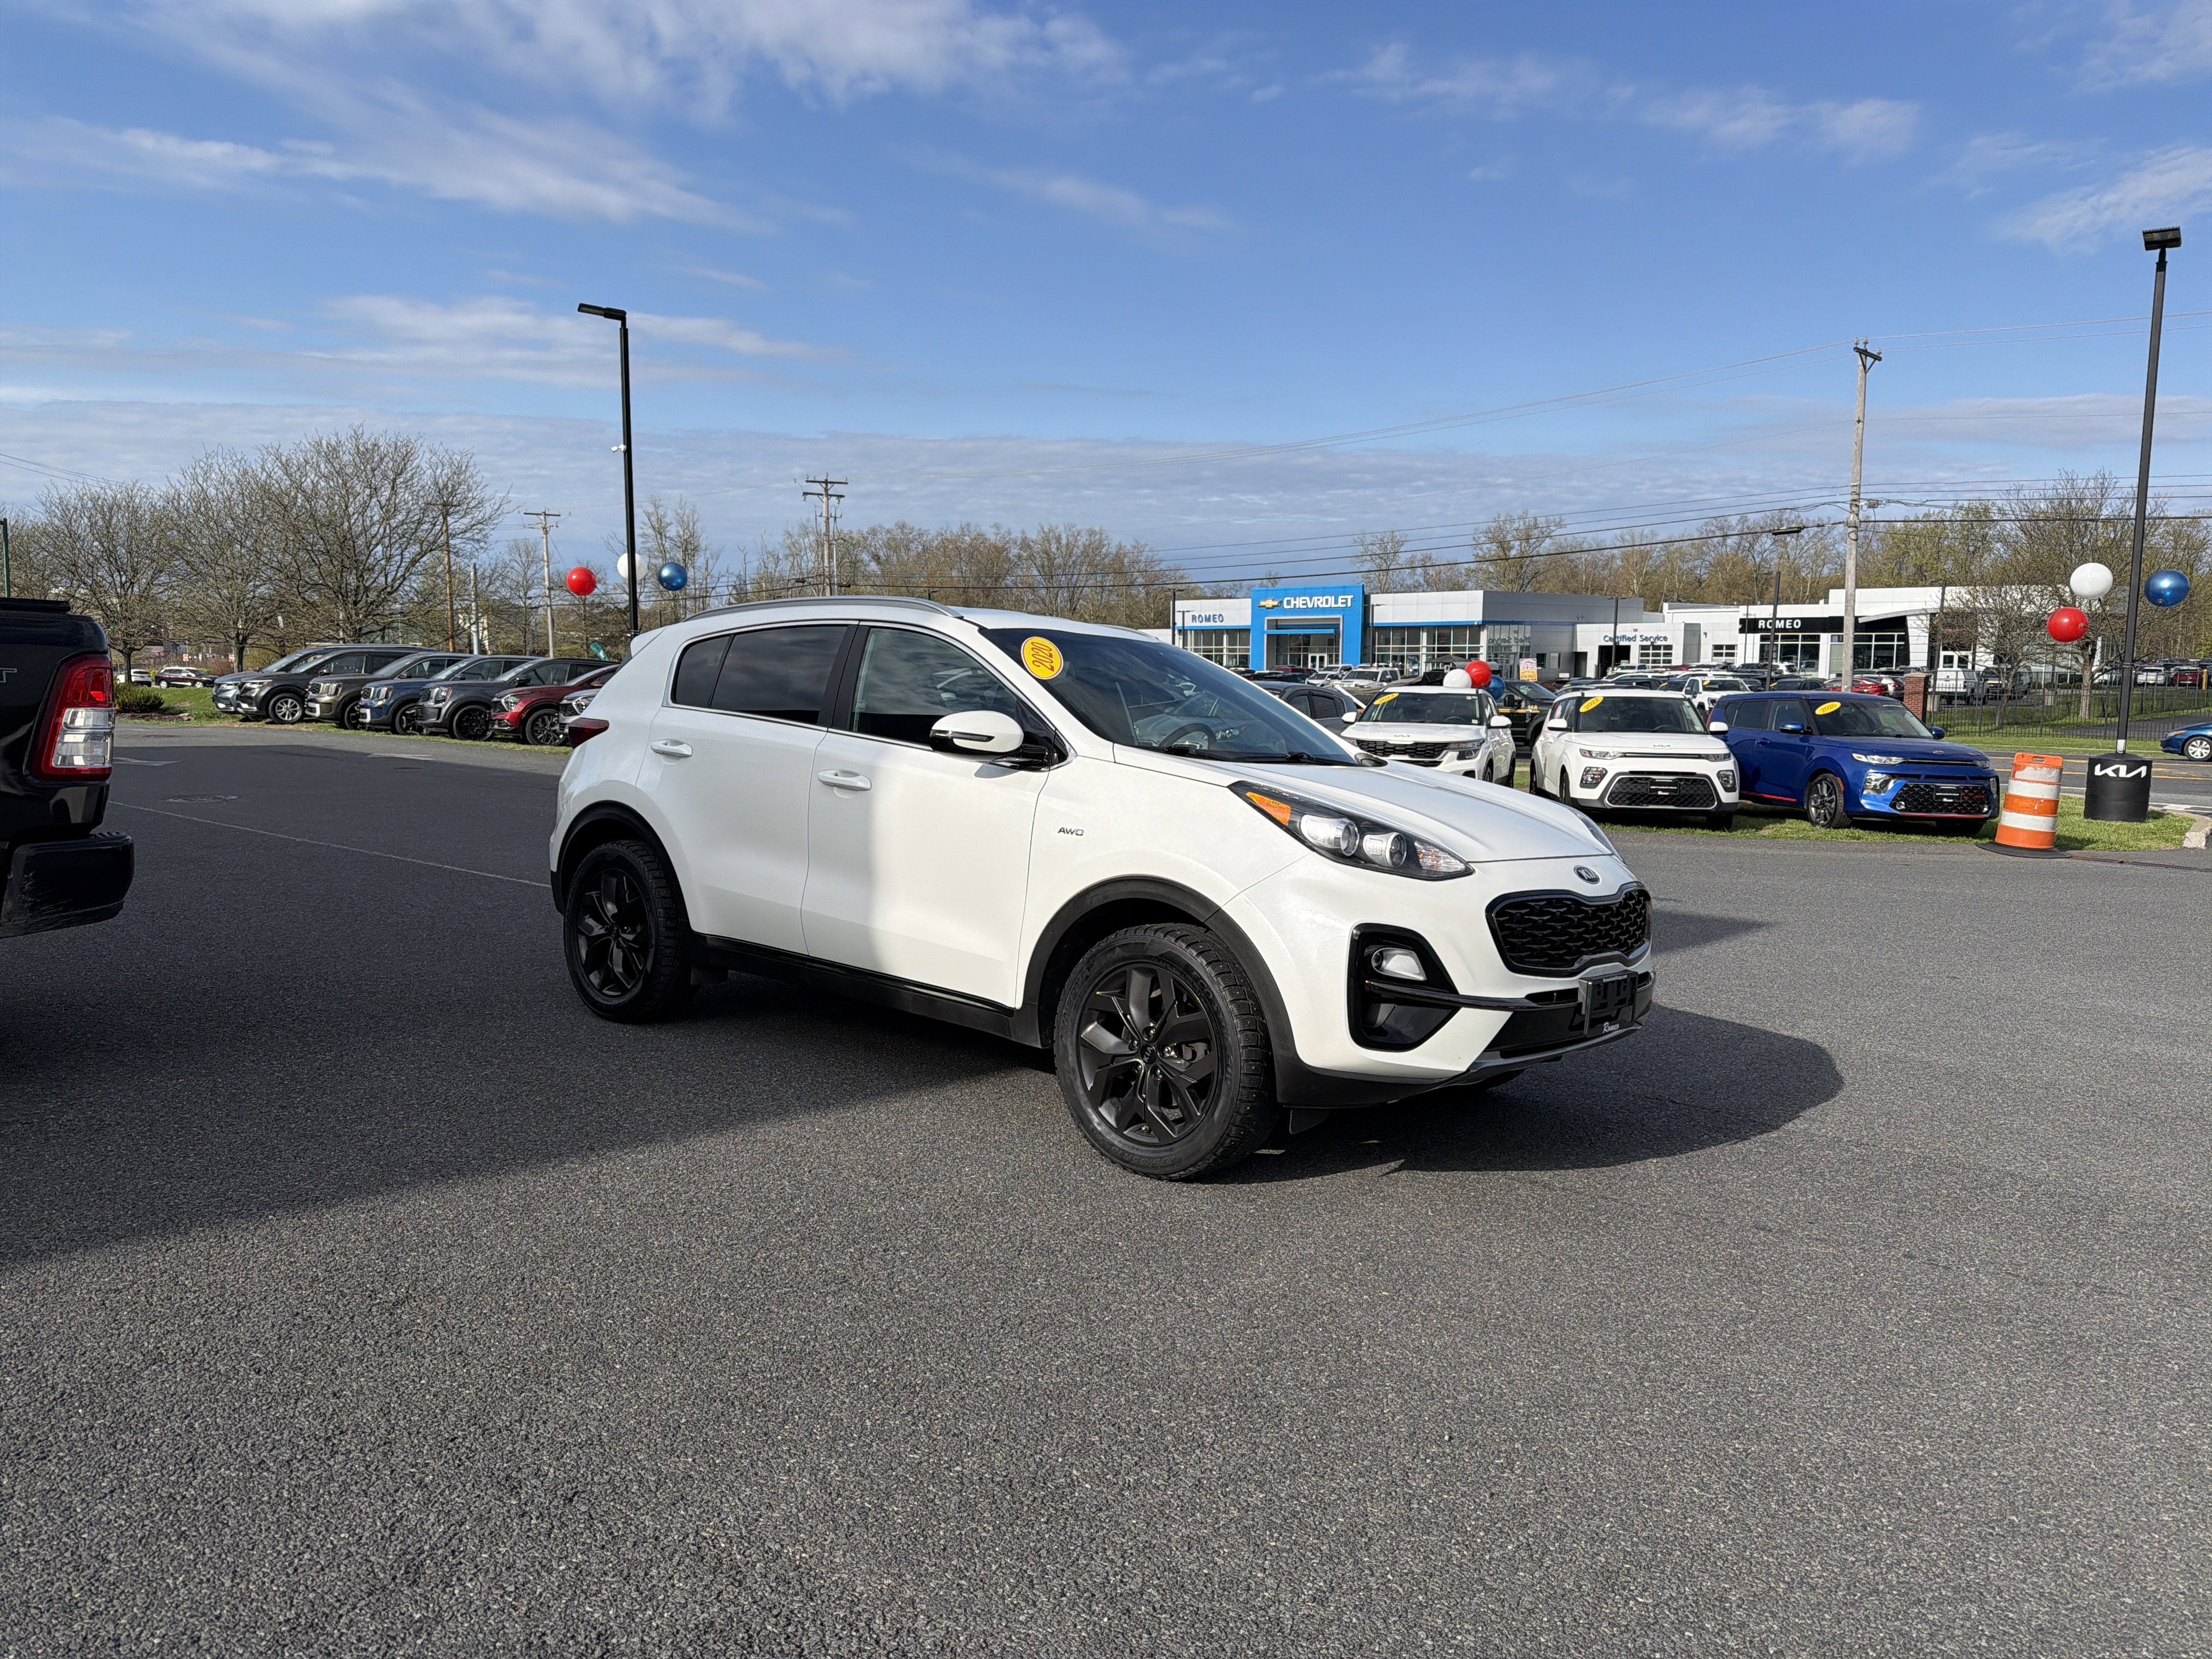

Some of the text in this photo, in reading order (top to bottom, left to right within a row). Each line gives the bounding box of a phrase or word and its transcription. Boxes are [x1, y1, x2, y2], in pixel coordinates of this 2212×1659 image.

[1283, 595, 1354, 609] CHEVROLET
[1191, 613, 1224, 623] ROMEO
[1758, 619, 1801, 629] ROMEO
[1639, 634, 1668, 642] Service
[1030, 641, 1054, 672] 2020
[1820, 703, 1837, 713] 2020
[2095, 763, 2147, 778] KIA
[1057, 827, 1084, 836] AWD
[1602, 1022, 1620, 1034] Romeo
[1143, 1046, 1153, 1063] KIA
